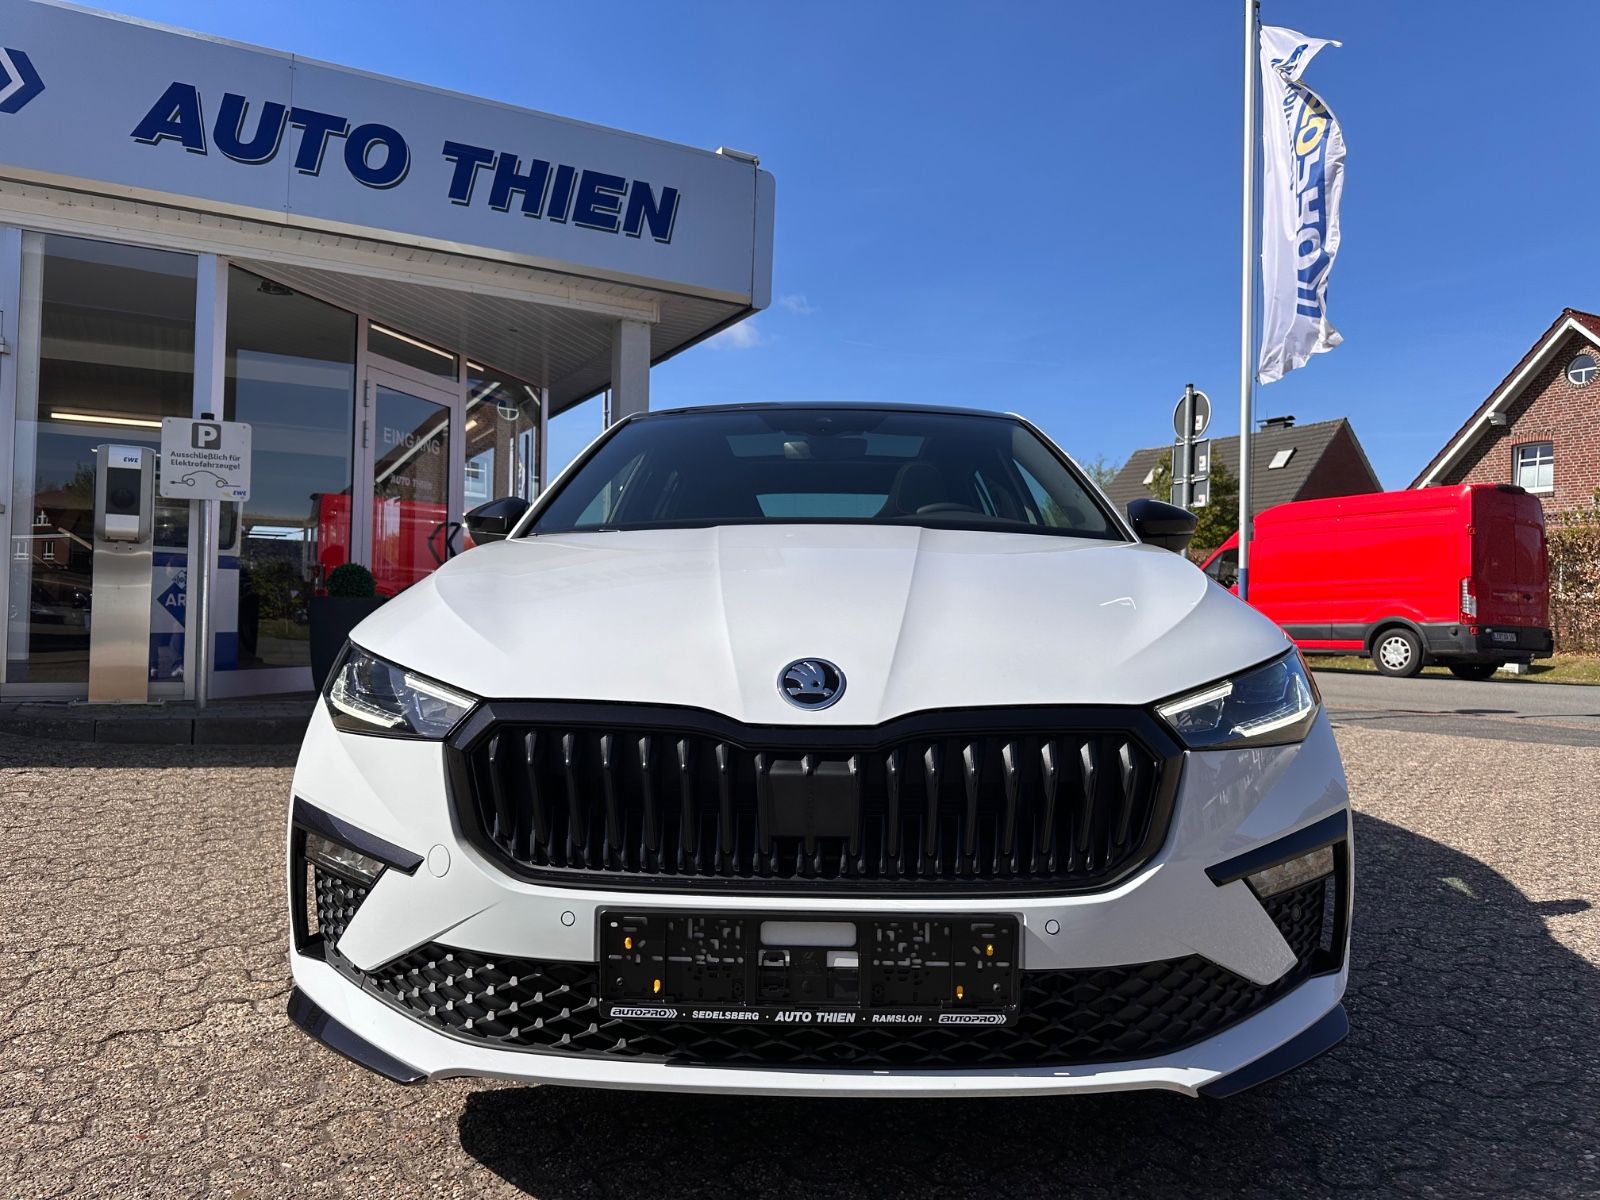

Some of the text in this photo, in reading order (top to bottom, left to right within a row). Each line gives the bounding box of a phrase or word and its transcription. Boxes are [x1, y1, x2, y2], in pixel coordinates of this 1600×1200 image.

[130, 81, 682, 244] AUTO THIEN
[198, 425, 218, 448] P
[383, 427, 441, 455] EINGANG
[170, 451, 241, 462] Ausschließlich für
[165, 593, 186, 607] AR
[692, 1010, 760, 1020] SEDELSBERG
[774, 1011, 812, 1023] AUTO
[816, 1012, 856, 1023] THIEN
[872, 1014, 923, 1023] RAMSLOH
